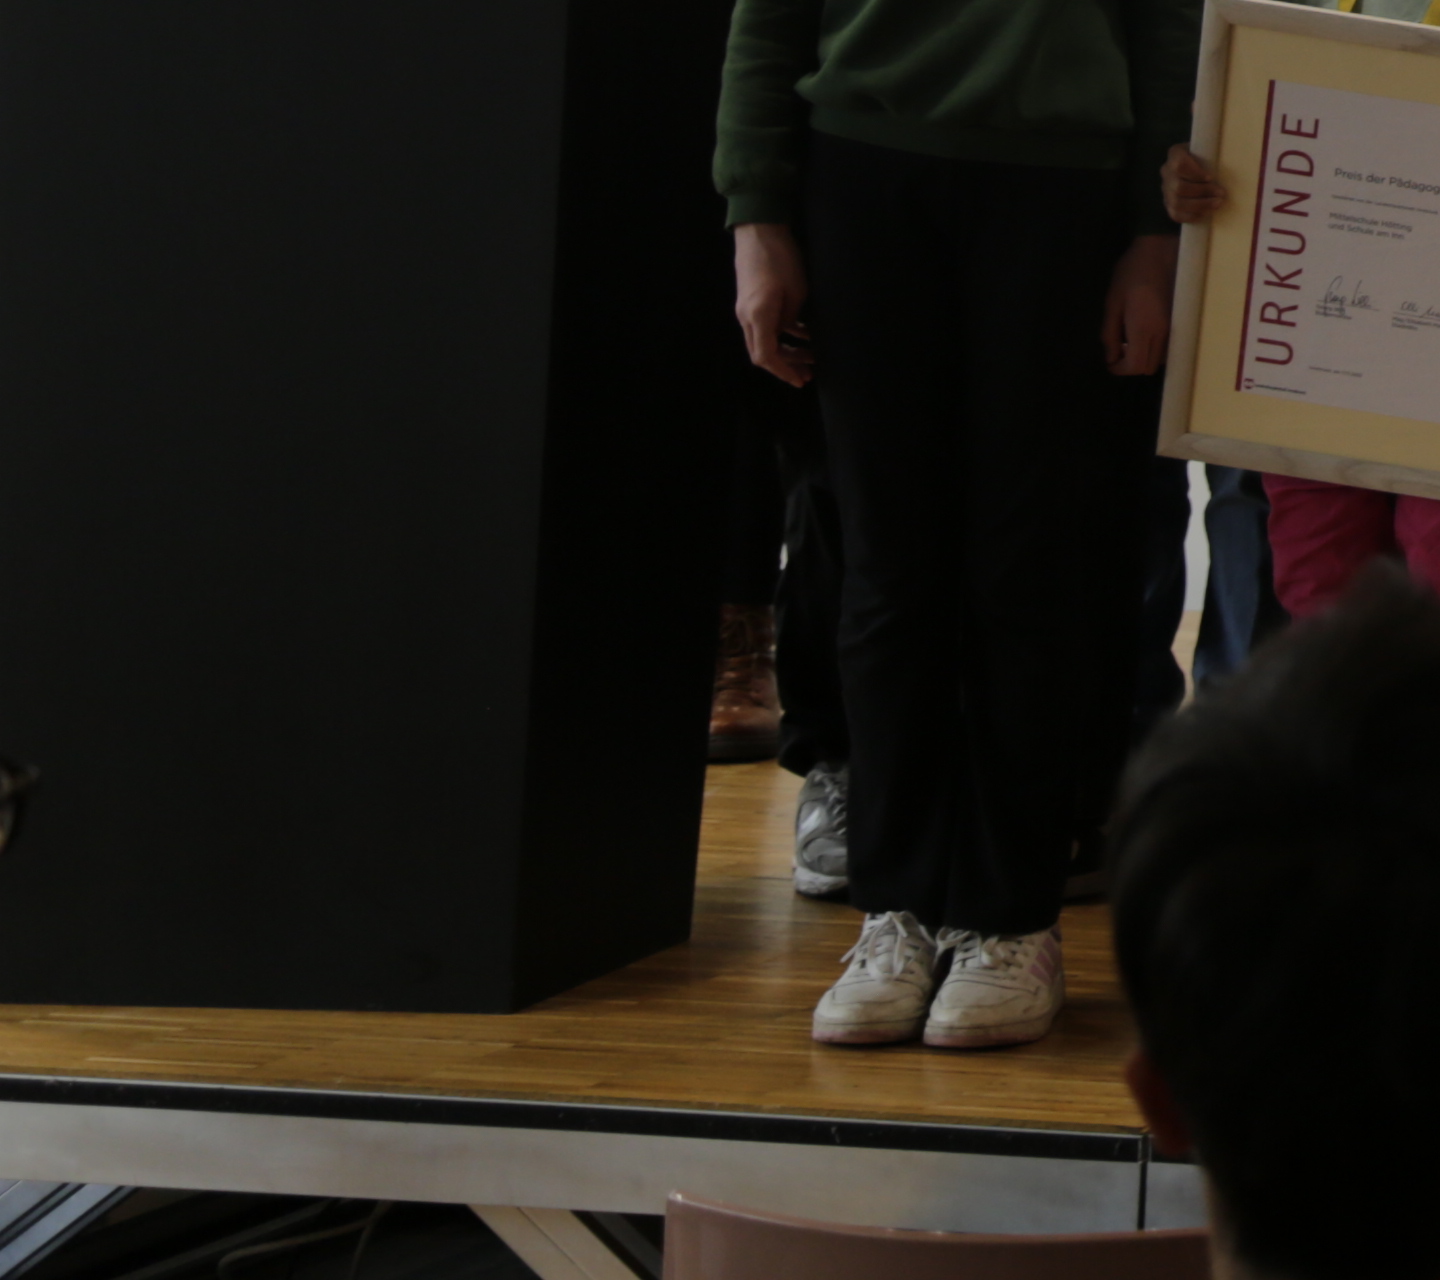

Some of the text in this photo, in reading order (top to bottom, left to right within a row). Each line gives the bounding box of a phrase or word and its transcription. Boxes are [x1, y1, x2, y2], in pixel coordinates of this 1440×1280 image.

[1254, 113, 1320, 366] URKUNDE
[1334, 167, 1363, 181] Preis
[1365, 173, 1386, 184] der
